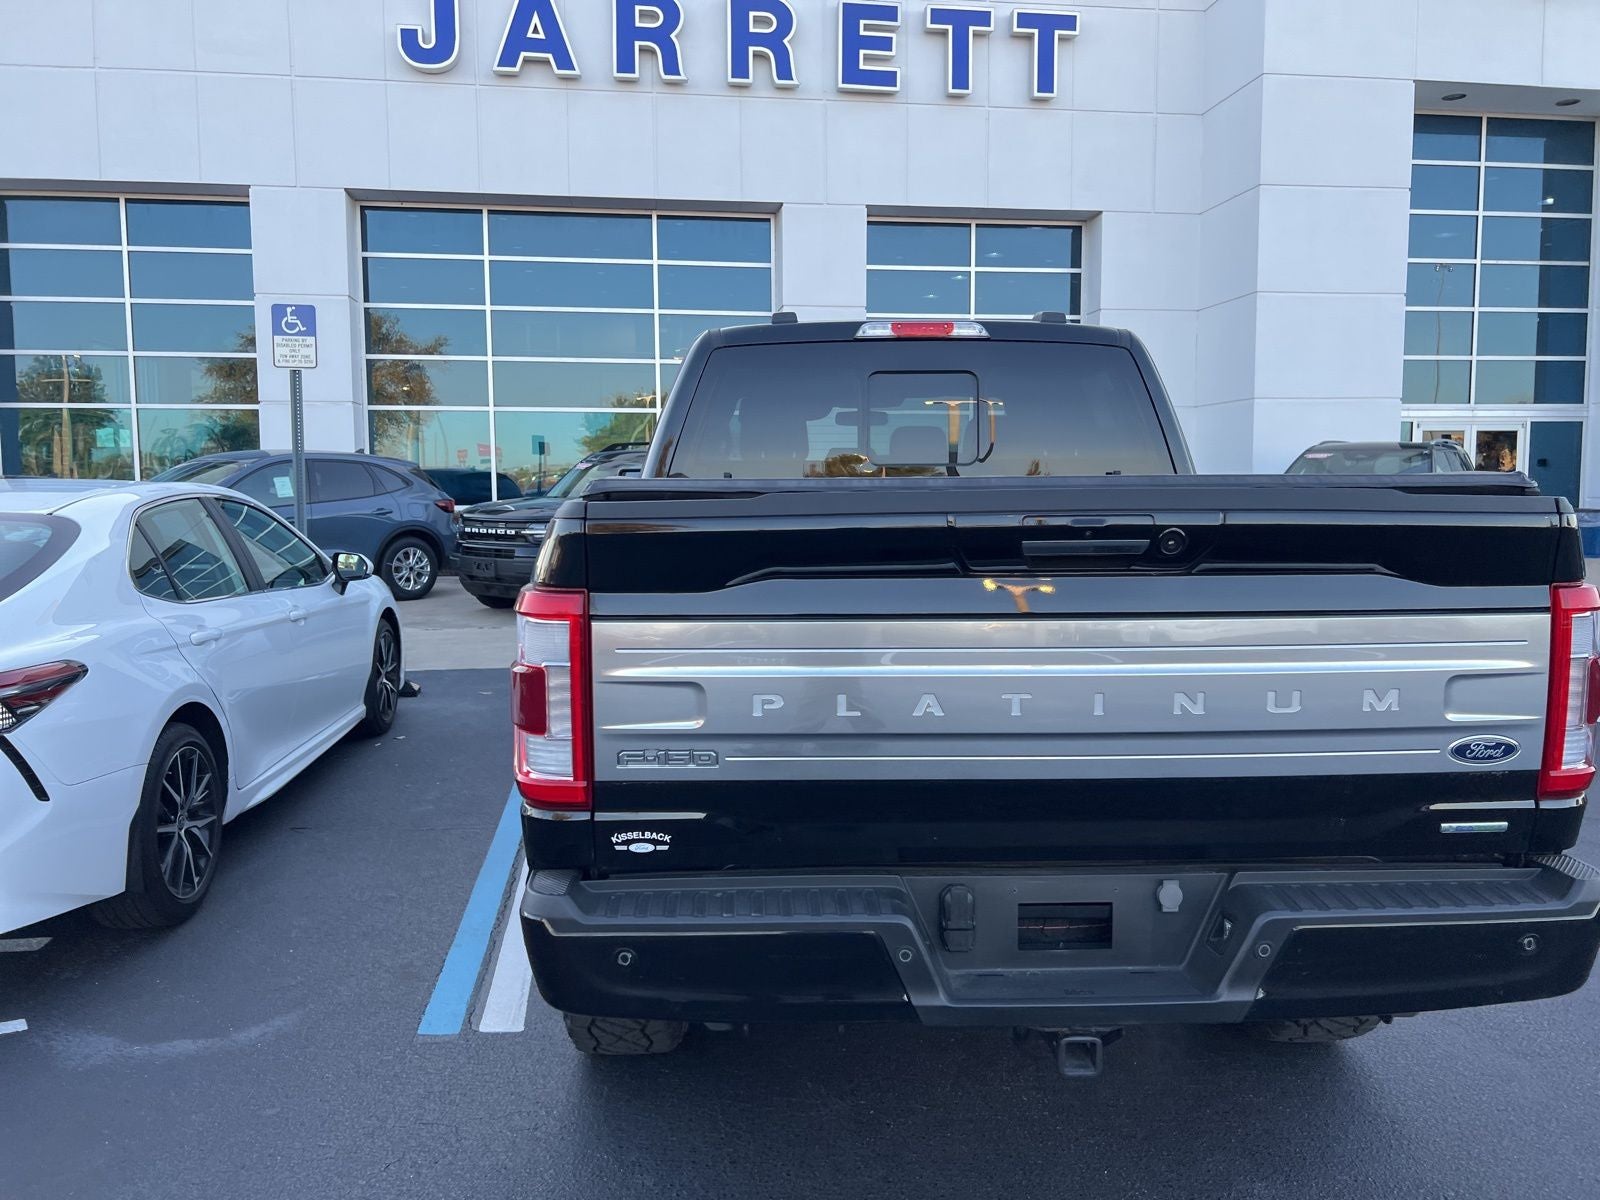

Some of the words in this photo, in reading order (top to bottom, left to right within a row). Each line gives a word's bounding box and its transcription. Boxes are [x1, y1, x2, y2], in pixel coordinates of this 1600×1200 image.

[397, 0, 1080, 100] JARRETT
[464, 527, 516, 535] BRONCO
[751, 688, 1401, 717] PLATINUM
[1465, 741, 1506, 758] Ford
[616, 749, 719, 769] F-150
[611, 831, 672, 843] KISSELBACK
